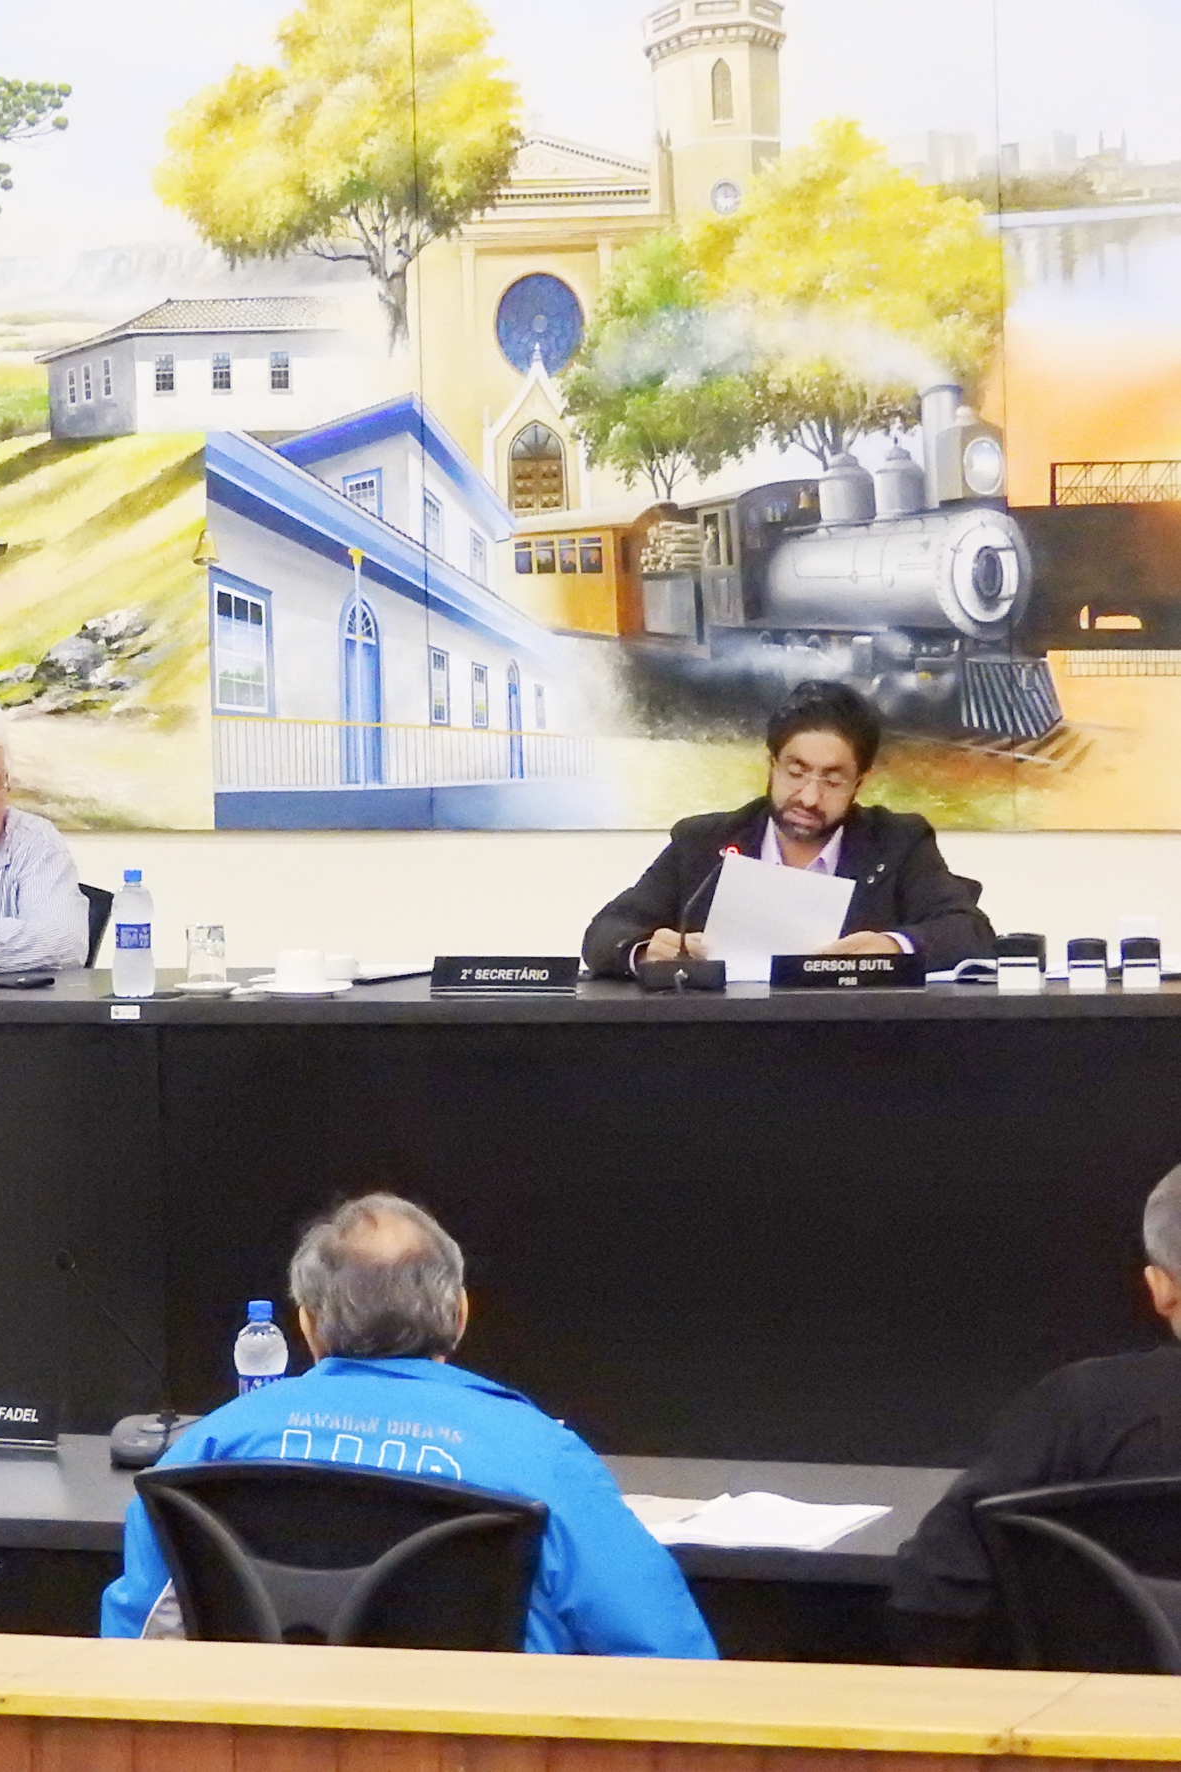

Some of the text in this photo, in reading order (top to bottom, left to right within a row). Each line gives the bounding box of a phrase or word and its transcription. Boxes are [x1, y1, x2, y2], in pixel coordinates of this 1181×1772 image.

[803, 958, 895, 972] GERSON SUTIL
[474, 966, 550, 981] SECRETÁRIO
[837, 976, 858, 987] PSB
